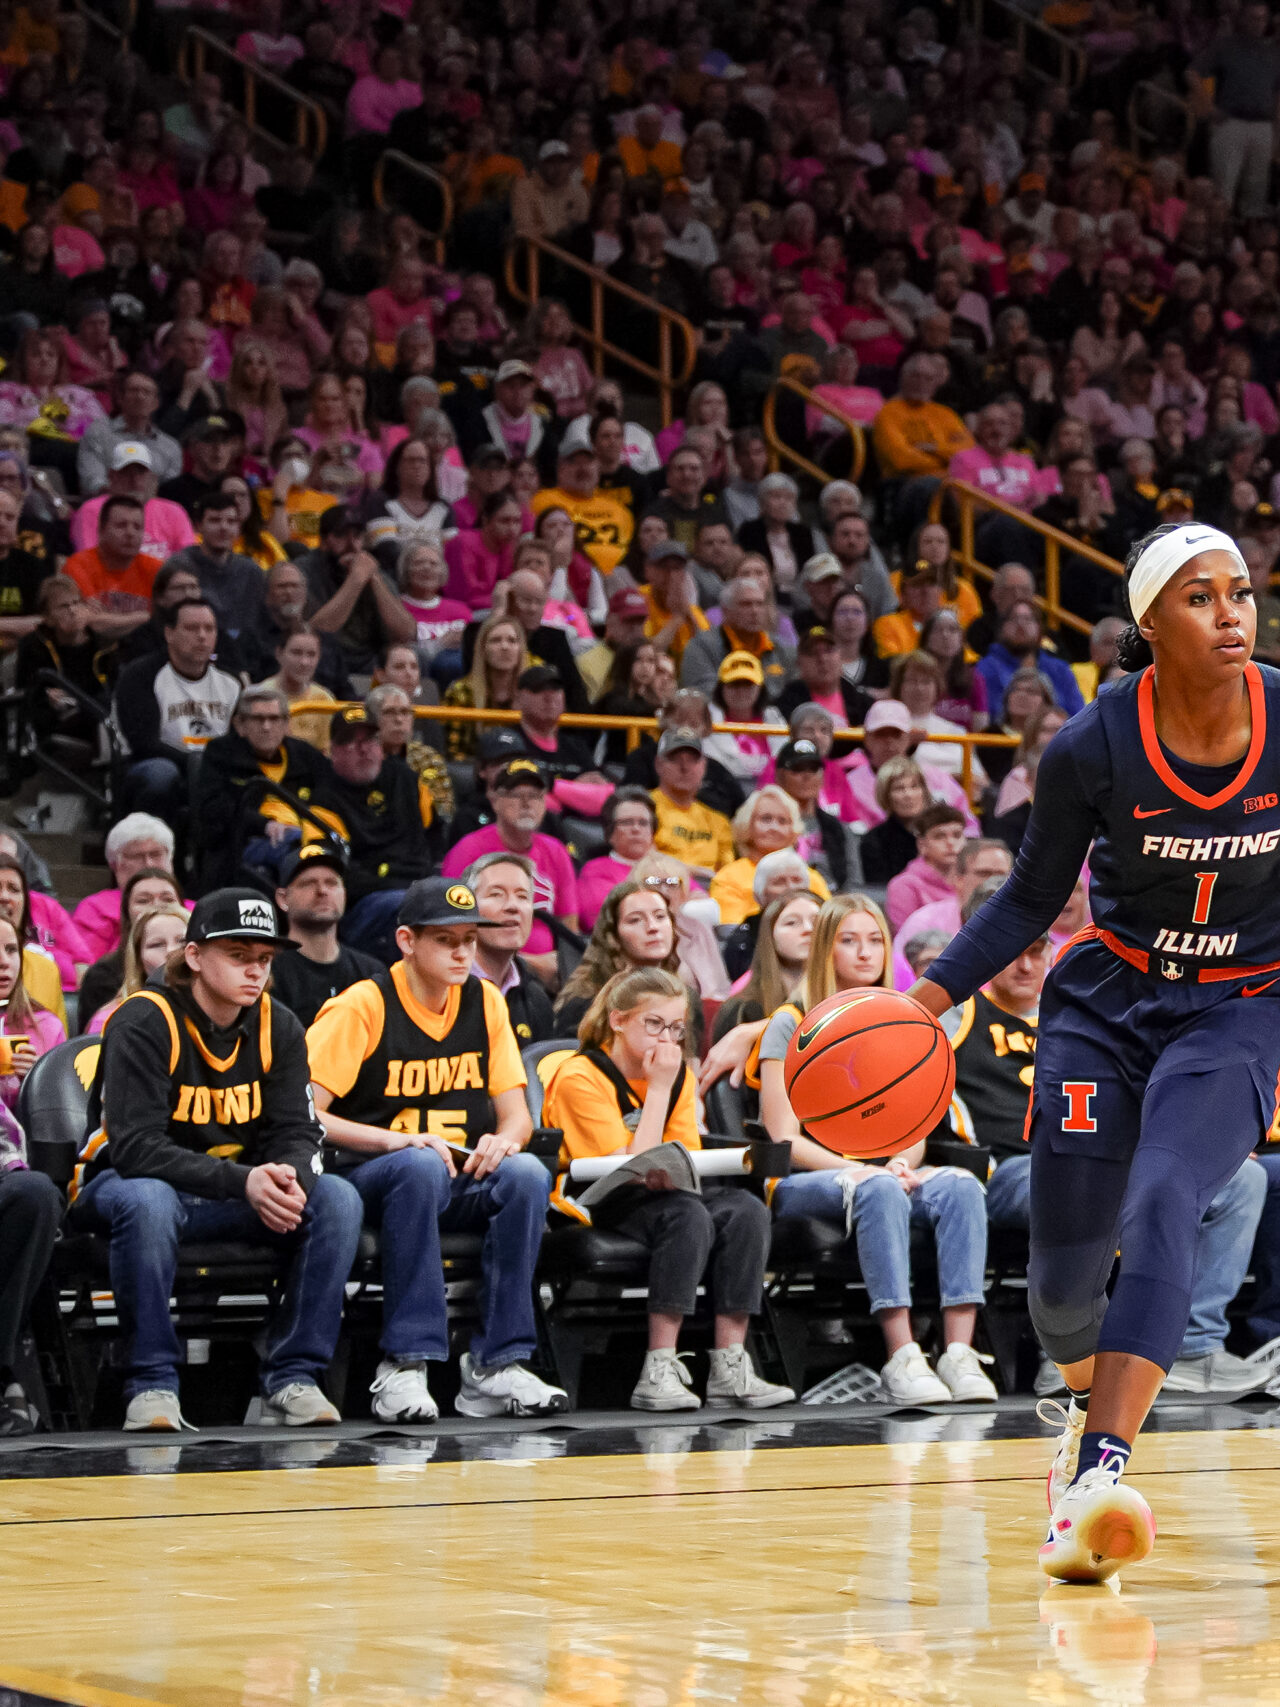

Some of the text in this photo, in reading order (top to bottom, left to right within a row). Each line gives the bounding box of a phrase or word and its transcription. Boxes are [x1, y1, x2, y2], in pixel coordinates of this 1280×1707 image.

[1192, 872, 1219, 924] 1
[1152, 928, 1238, 956] ILLINI
[384, 1052, 484, 1097] IOWA
[1062, 1082, 1097, 1132] I
